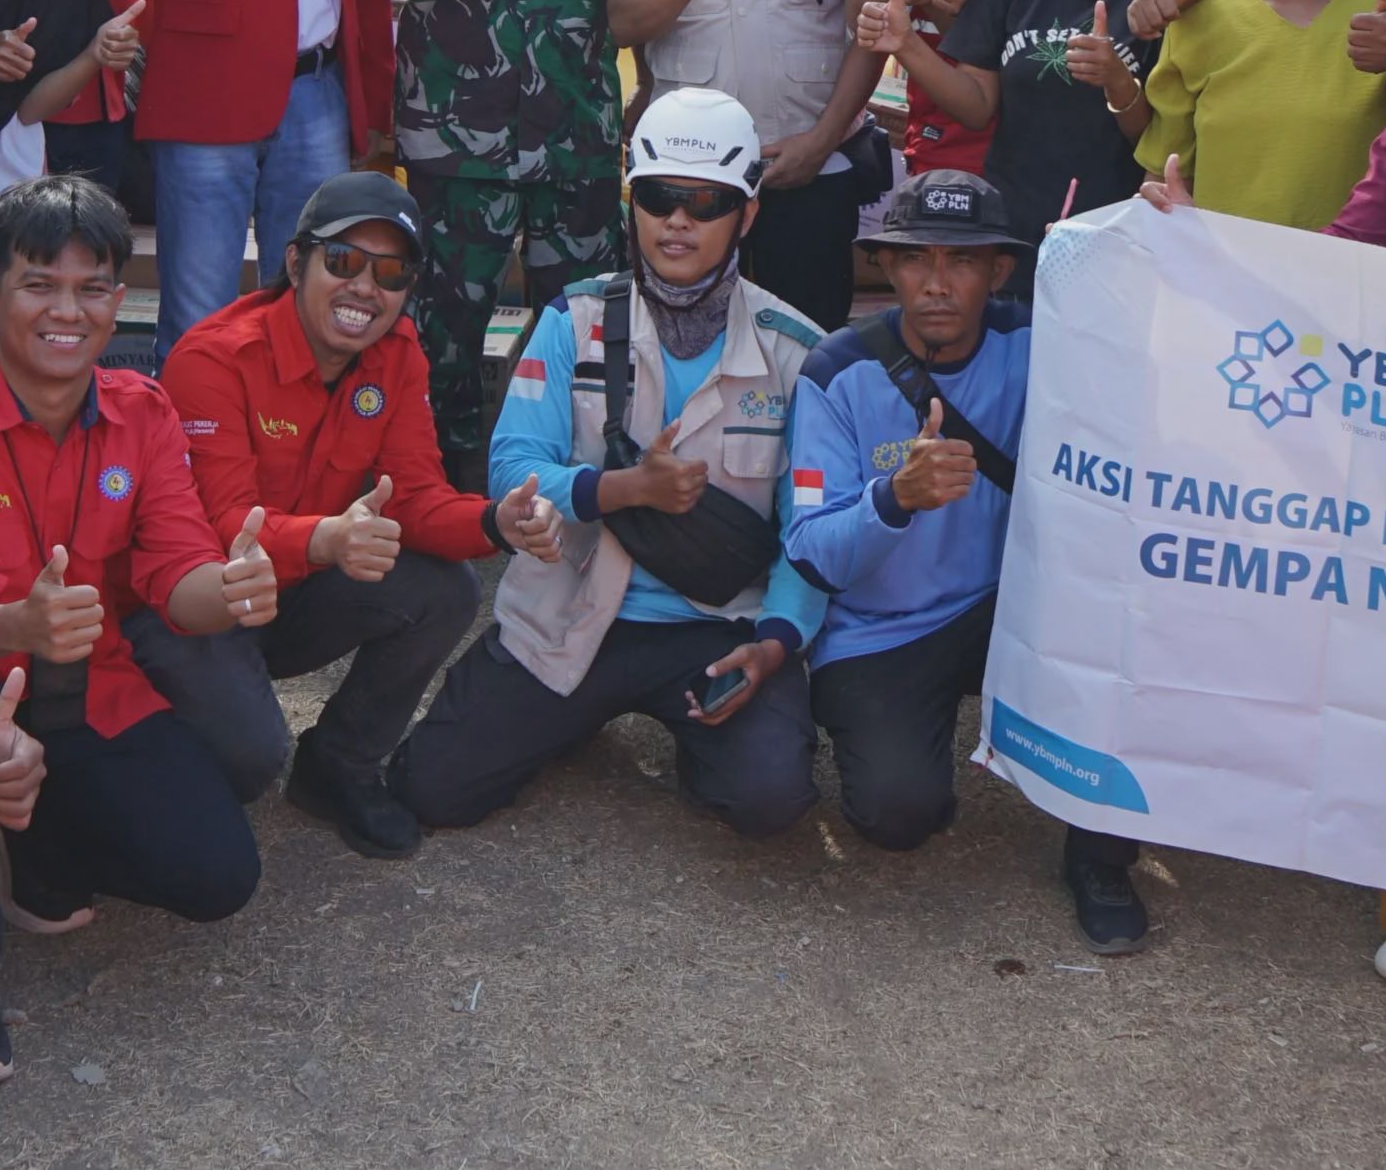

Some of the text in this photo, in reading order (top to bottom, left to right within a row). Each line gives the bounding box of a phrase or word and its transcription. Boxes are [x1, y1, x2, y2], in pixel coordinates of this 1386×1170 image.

[1000, 29, 1039, 67] DON'T
[664, 136, 717, 151] YBMPLN
[947, 193, 970, 202] YBM
[947, 201, 969, 210] PLN
[1340, 421, 1378, 439] Yayasan
[1051, 442, 1133, 504] AKSI
[1145, 470, 1371, 538] TANGGAP
[1139, 532, 1349, 605] GEMPA
[1005, 727, 1100, 787] www.ybmpln.org
